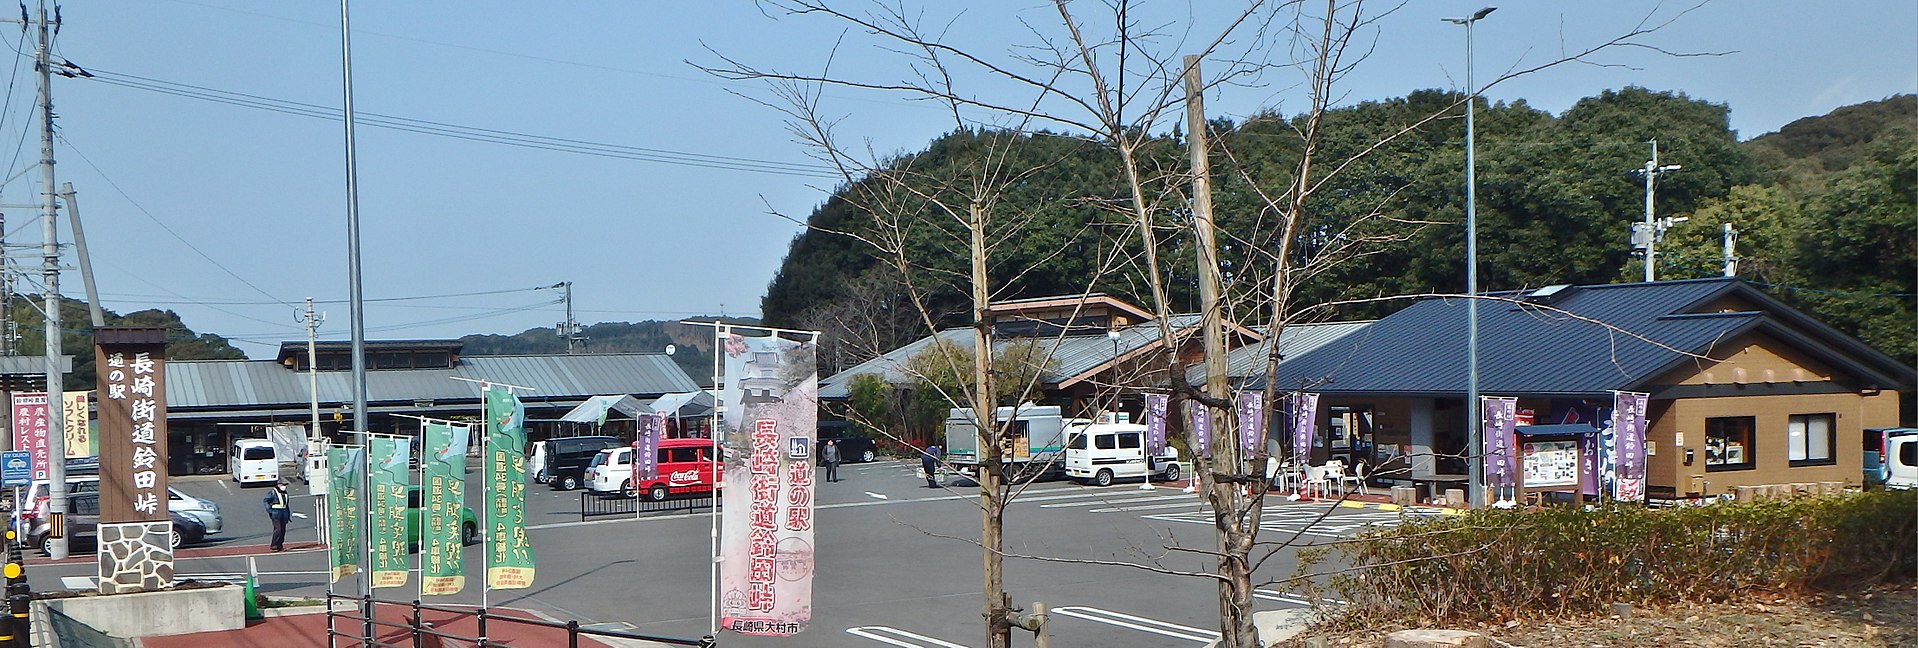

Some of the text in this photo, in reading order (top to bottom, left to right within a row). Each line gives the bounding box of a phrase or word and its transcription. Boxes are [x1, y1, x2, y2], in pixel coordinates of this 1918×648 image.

[108, 353, 126, 399] 道の駅
[34, 407, 47, 469] 農産物直売所
[64, 400, 76, 456] ソフトクリーム
[130, 352, 158, 514] 長崎街道鈴田峠
[749, 418, 779, 613] 長崎街道鈴田峠
[786, 461, 811, 530] 道の駅
[732, 620, 798, 633] 長崎県大村市
